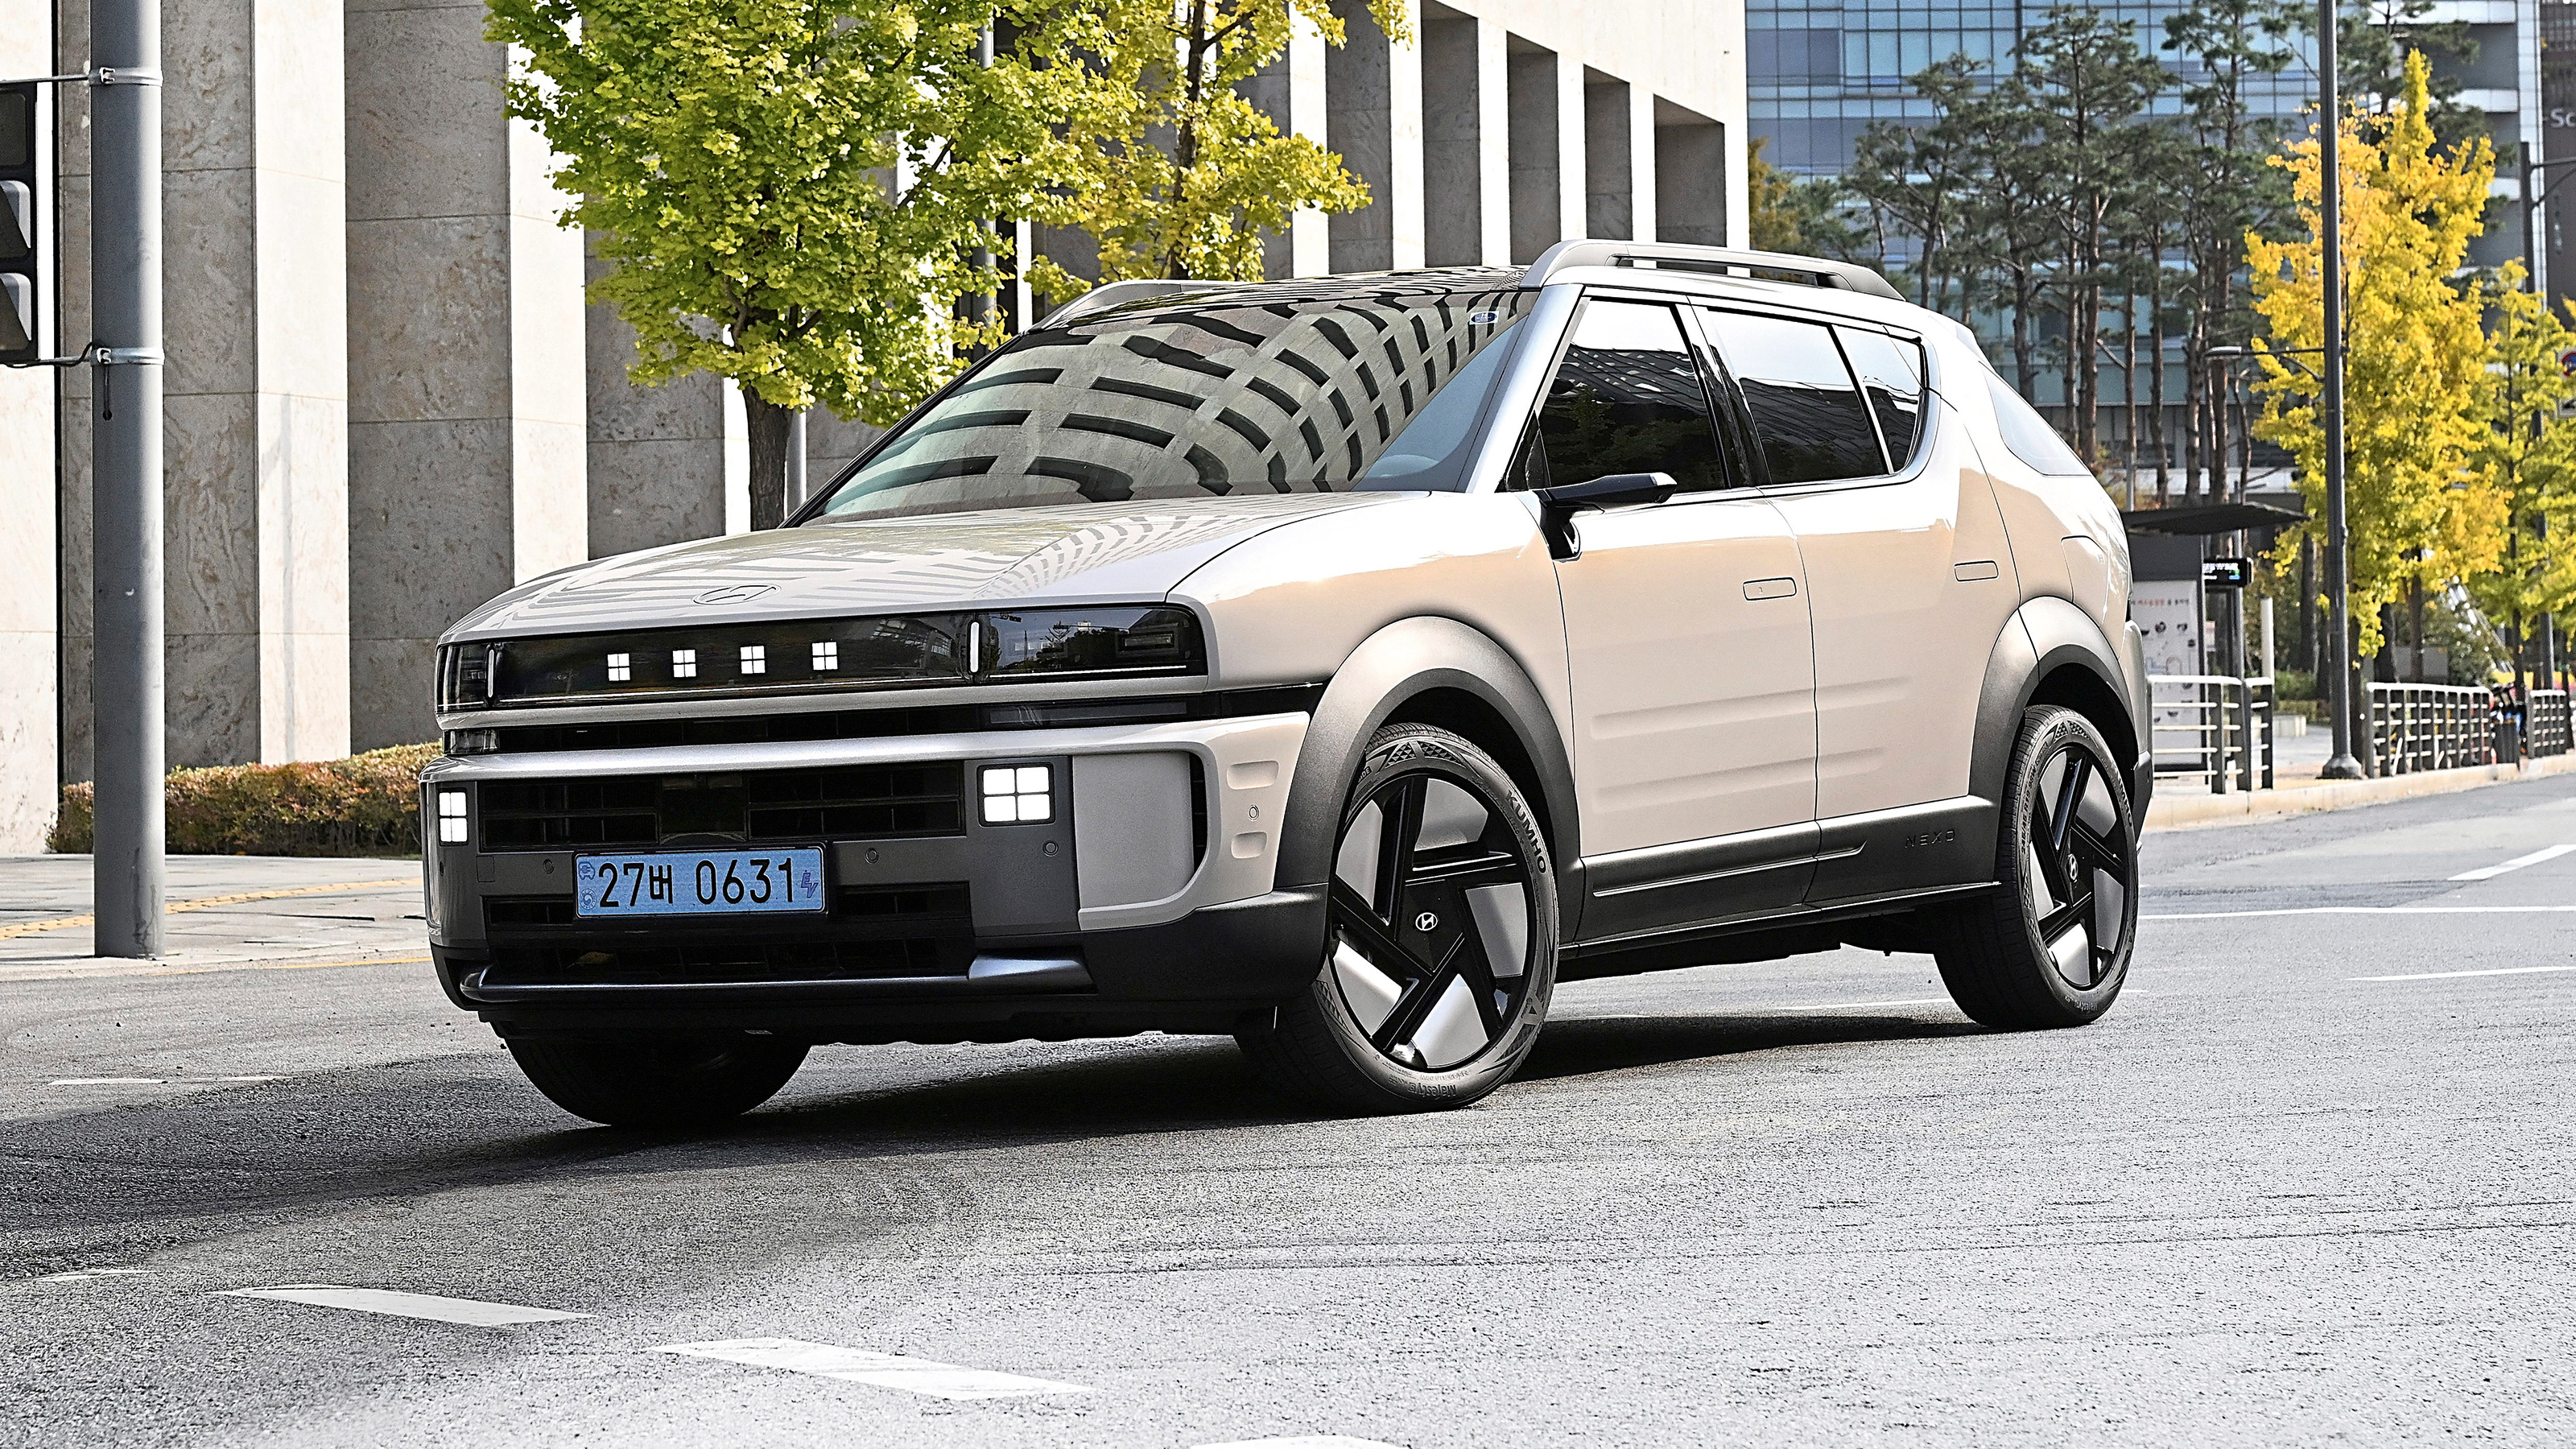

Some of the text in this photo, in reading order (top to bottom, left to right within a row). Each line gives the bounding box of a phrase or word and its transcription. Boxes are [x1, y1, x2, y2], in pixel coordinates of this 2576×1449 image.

[1505, 790, 1546, 873] KUMHO
[1904, 828, 1956, 849] NEXO
[598, 862, 674, 908] 27버
[695, 857, 794, 906] 0631
[800, 869, 819, 899] EV
